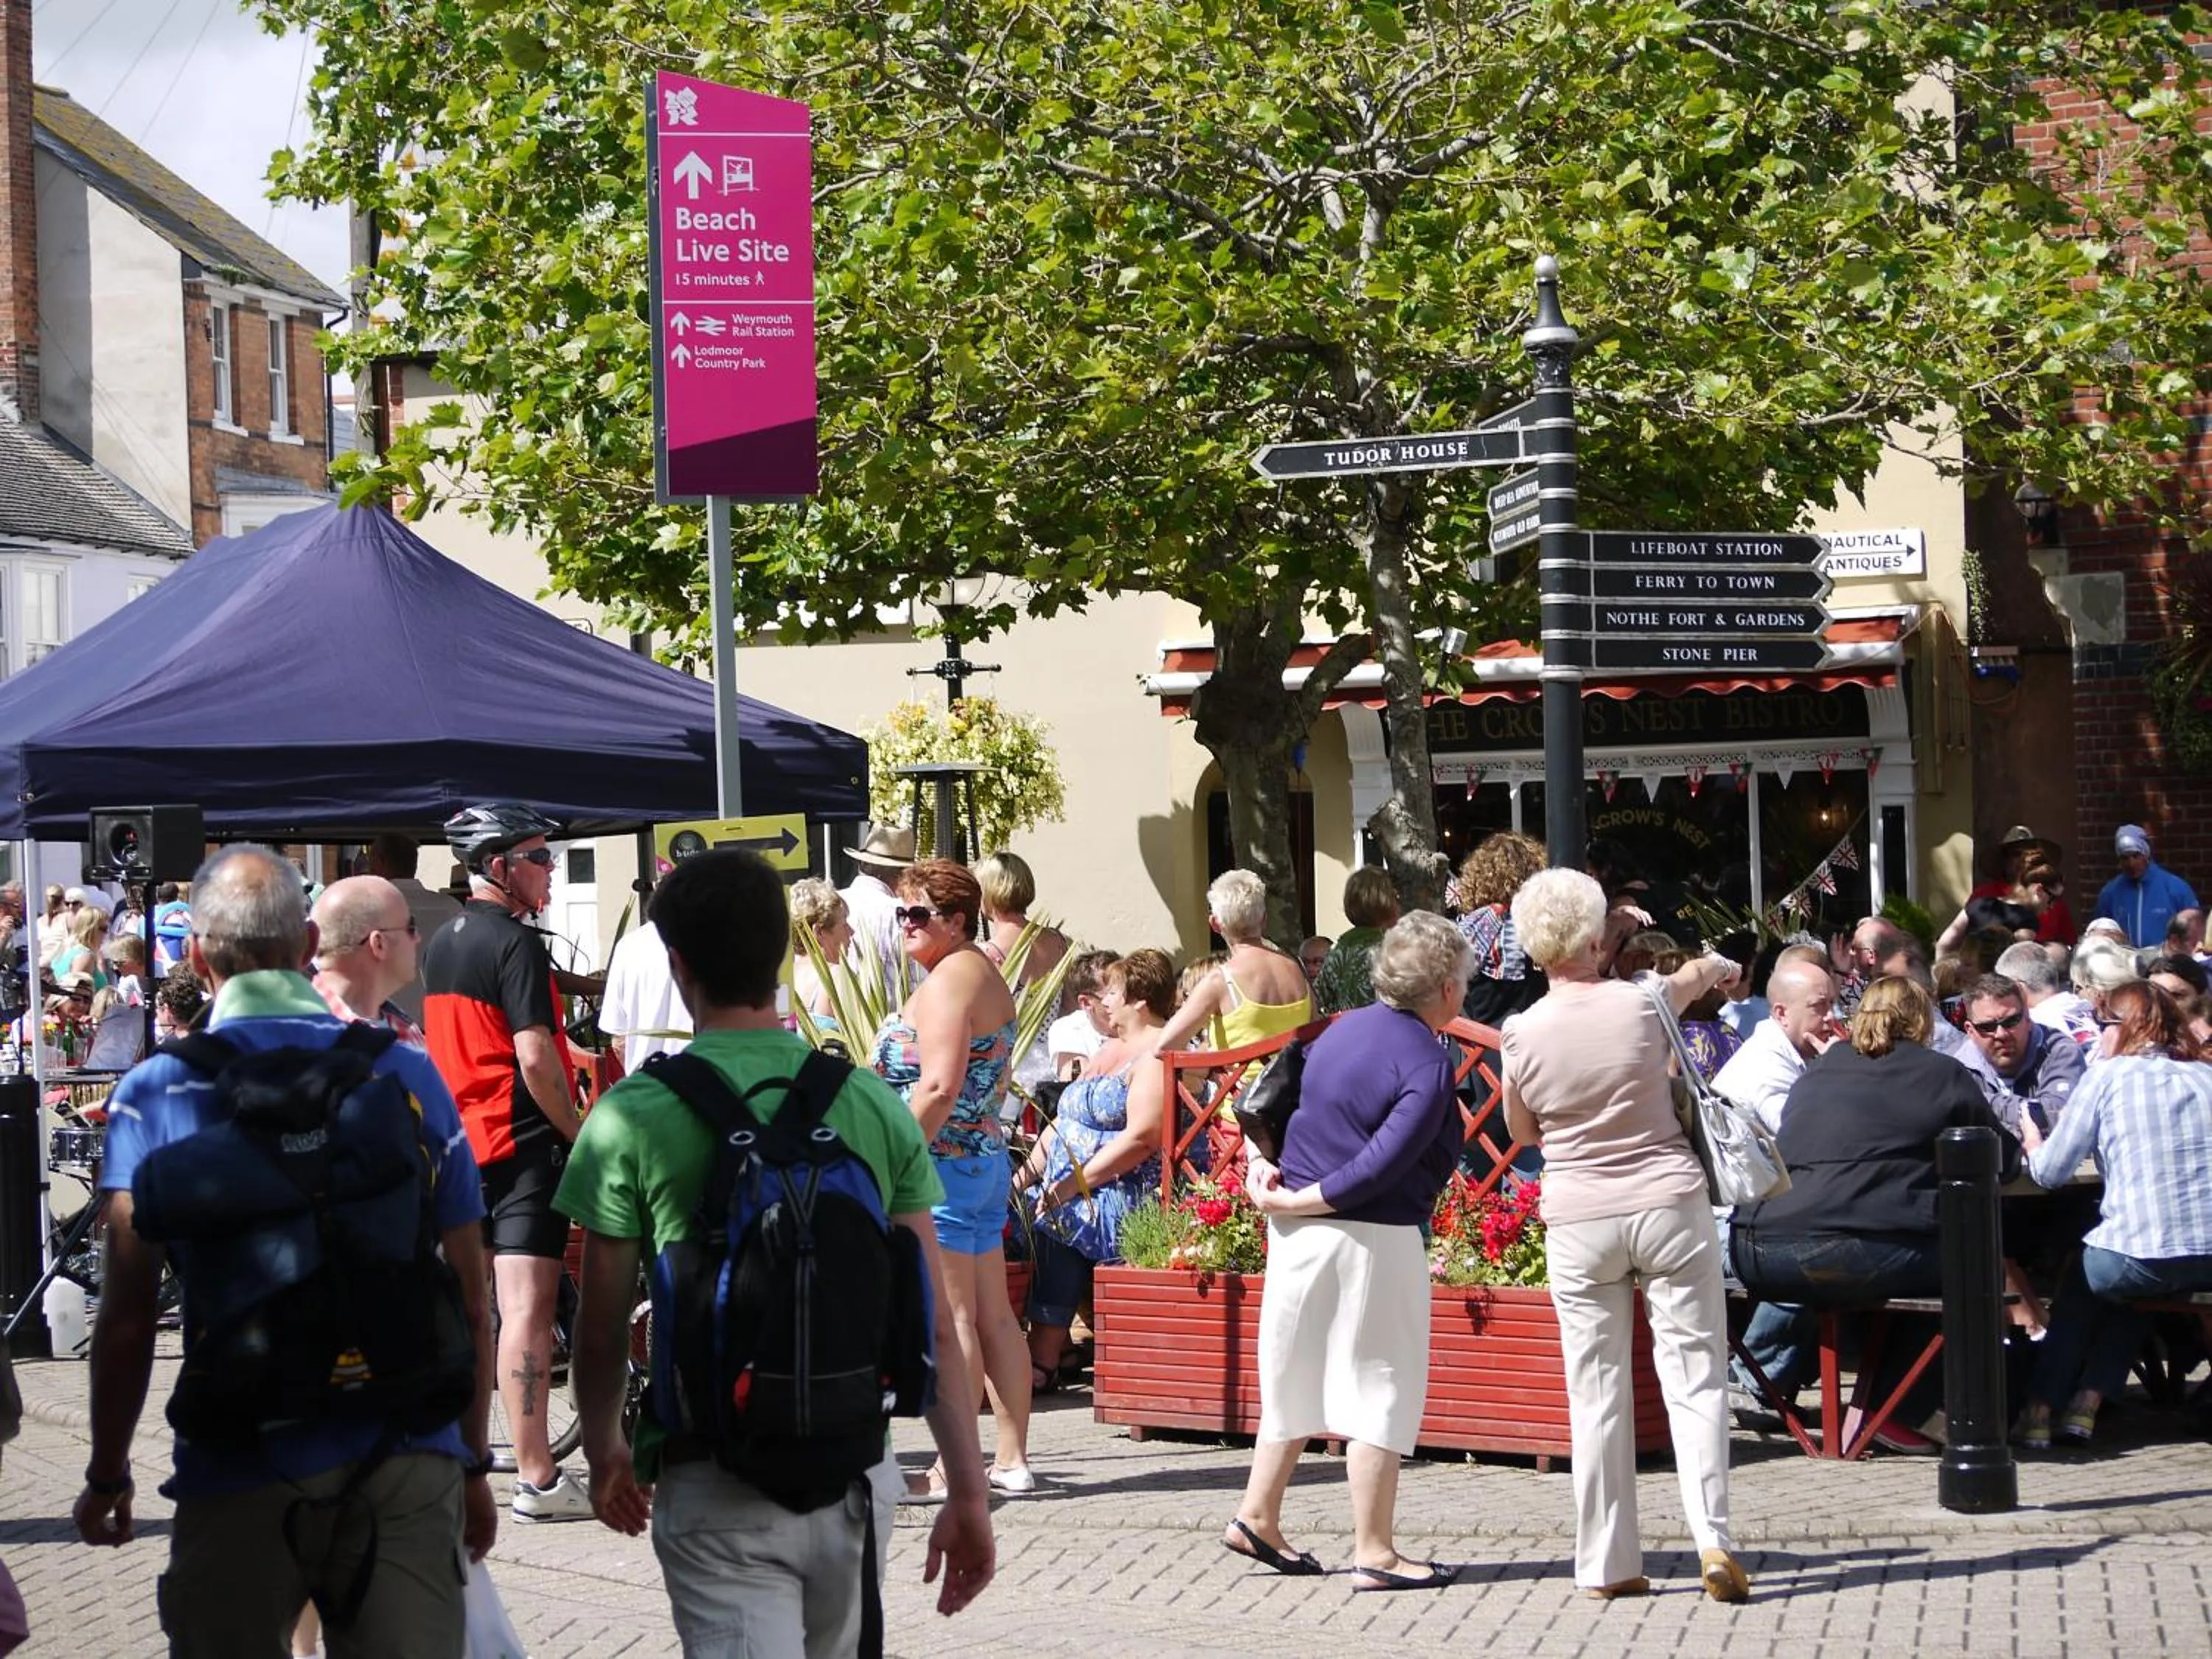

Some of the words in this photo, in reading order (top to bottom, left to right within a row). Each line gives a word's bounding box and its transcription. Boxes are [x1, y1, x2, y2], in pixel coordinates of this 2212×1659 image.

[675, 207, 756, 230] Beach
[676, 239, 730, 262] Live
[738, 239, 790, 262] Site
[676, 274, 689, 285] 15
[695, 272, 750, 285] minutes
[731, 313, 793, 325] Weymouth
[732, 326, 752, 337] Rail
[756, 326, 794, 337] Station
[694, 345, 743, 355] Lodmoor
[695, 358, 740, 370] Country
[742, 357, 766, 368] Park
[1324, 448, 1392, 466] TUDOR
[1401, 442, 1468, 460] HOUSE
[1823, 534, 1903, 548] NAUTICAL
[1631, 542, 1708, 555] LIFEBOAT
[1716, 543, 1783, 555] STATION
[1824, 556, 1902, 571] ANTIQUES
[1635, 575, 1686, 588] FERRY
[1696, 575, 1717, 588] TO
[1726, 576, 1775, 588] TOWN
[1606, 612, 1659, 625] NOTHE
[1669, 613, 1706, 625] FORT
[1715, 613, 1726, 625] &
[1736, 613, 1806, 626] GARDENS
[1663, 648, 1711, 661] STONE
[1724, 648, 1758, 661] PIER
[1429, 709, 1469, 740] HE
[1621, 698, 1706, 732] NEST
[1724, 694, 1843, 729] BISTRO
[1673, 818, 1711, 850] NEST
